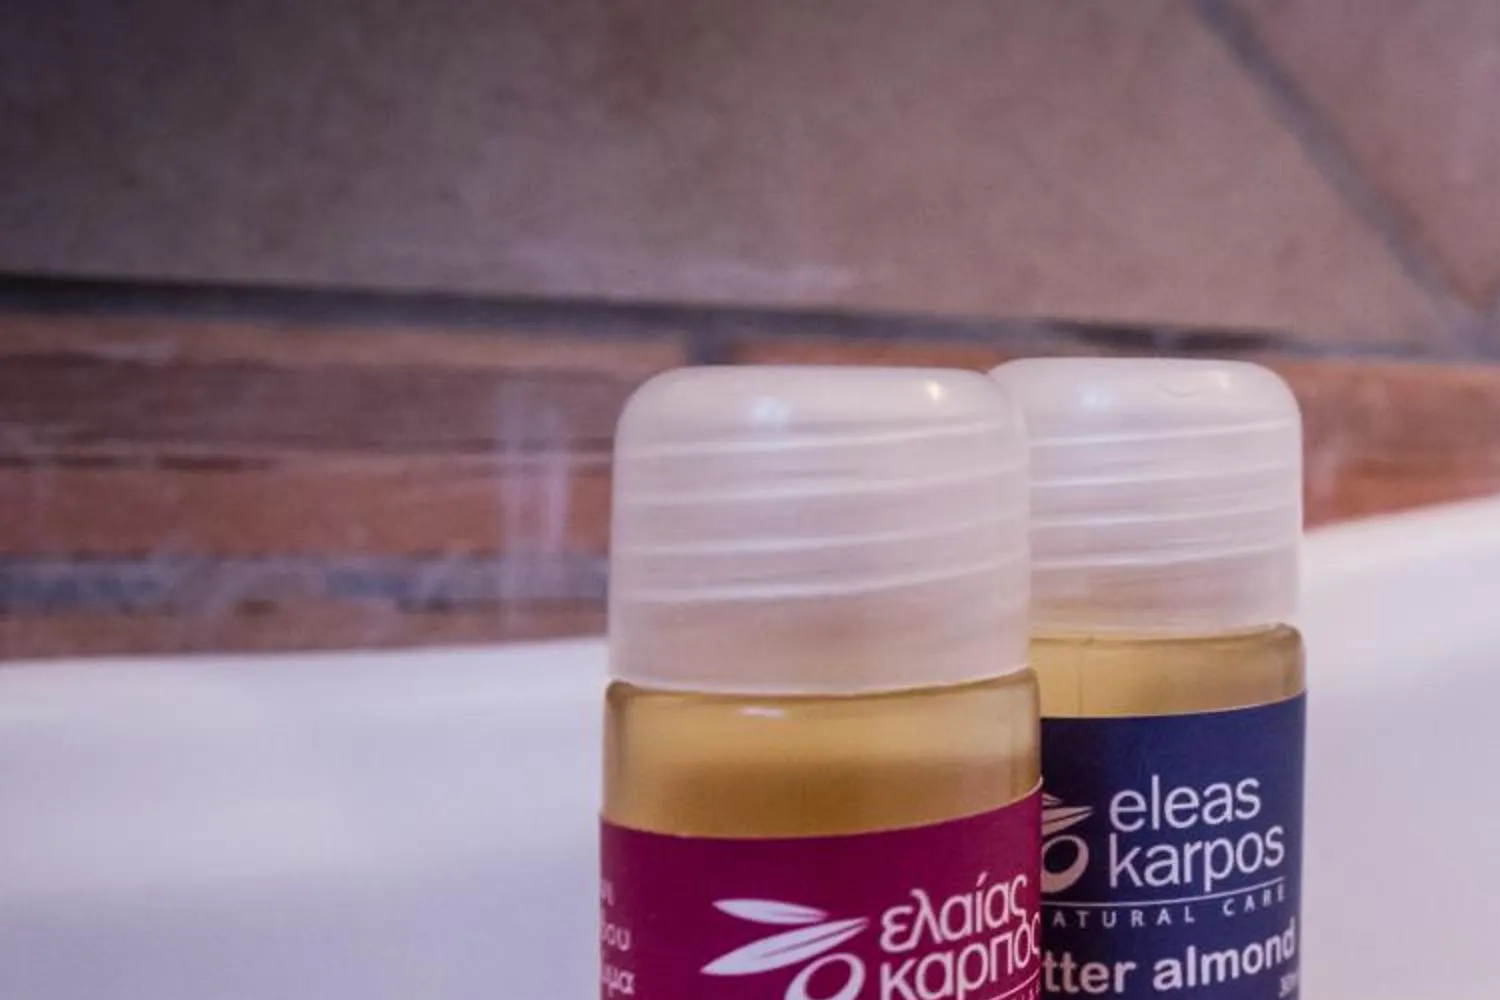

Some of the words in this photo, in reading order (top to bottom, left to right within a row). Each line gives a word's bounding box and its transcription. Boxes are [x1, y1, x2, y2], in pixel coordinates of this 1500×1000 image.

[1109, 774, 1261, 832] eleas
[1109, 825, 1285, 892] karpos
[879, 871, 1028, 954] ελαίας
[1051, 906, 1195, 928] ATURAL
[1222, 883, 1286, 917] CARE
[1042, 949, 1137, 993] tter
[1152, 916, 1297, 992] almond
